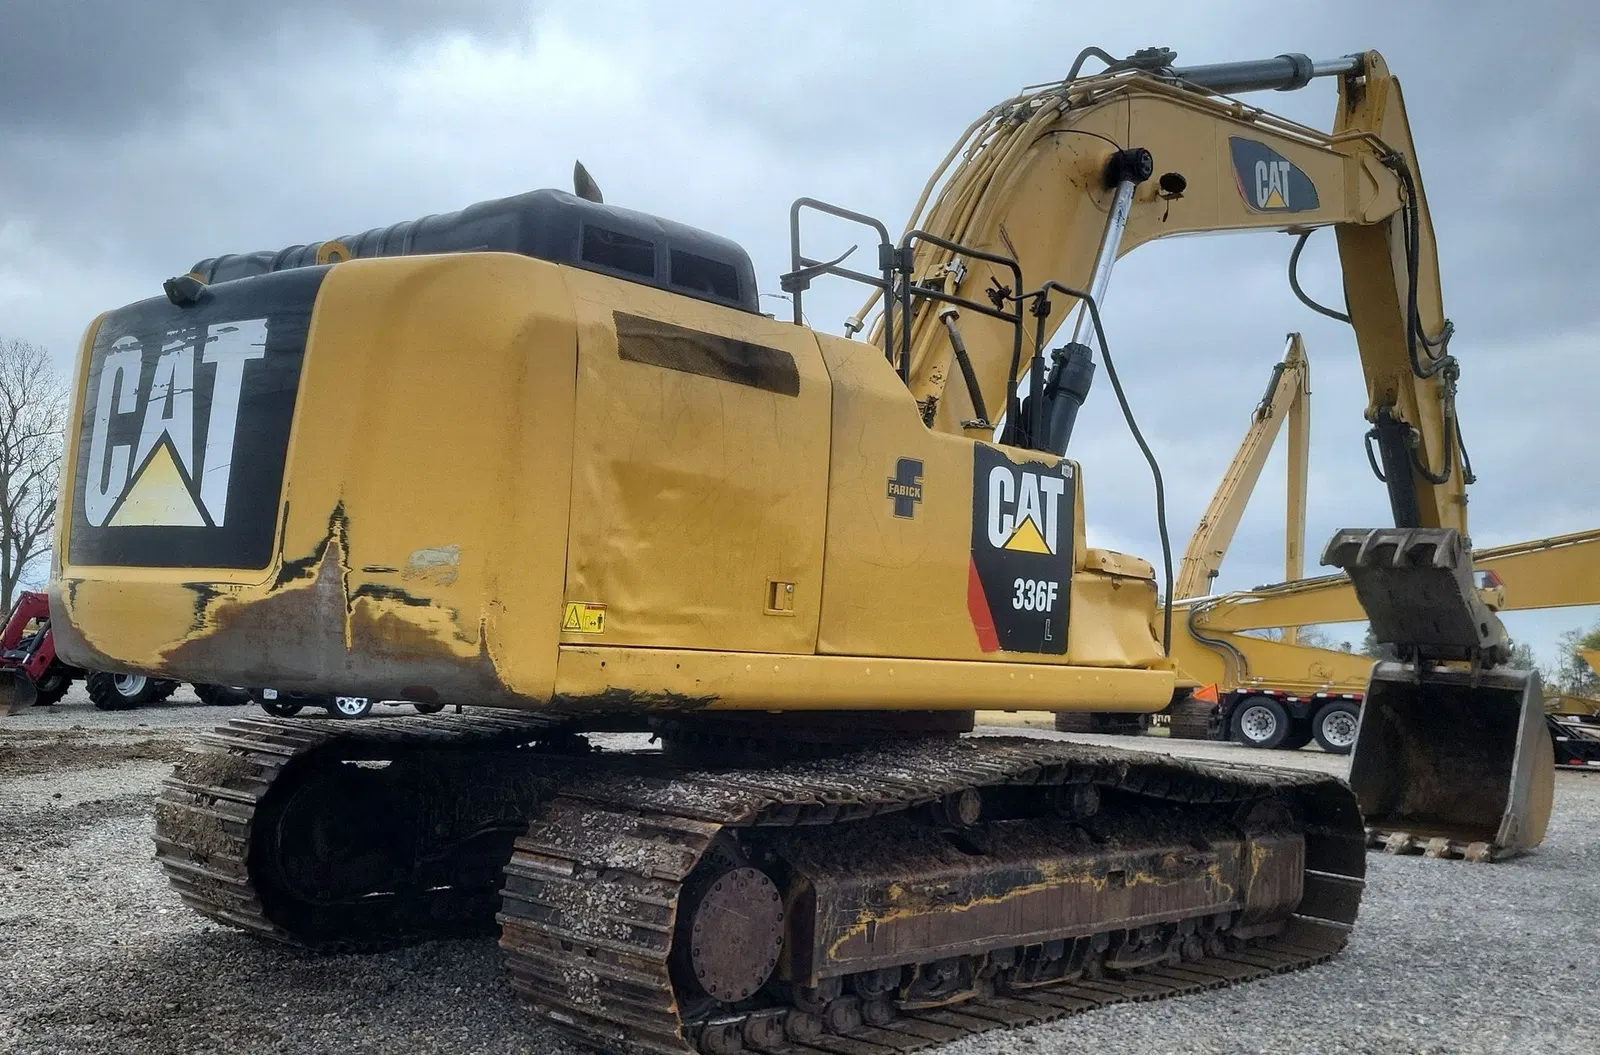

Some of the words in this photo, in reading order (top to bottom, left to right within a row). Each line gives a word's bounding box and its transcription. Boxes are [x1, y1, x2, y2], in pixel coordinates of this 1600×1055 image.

[1255, 160, 1290, 208] CAT
[85, 318, 269, 527] CAT
[889, 483, 921, 498] FABICK
[988, 466, 1064, 555] CAT
[1012, 577, 1059, 612] 336F
[1044, 618, 1053, 641] L
